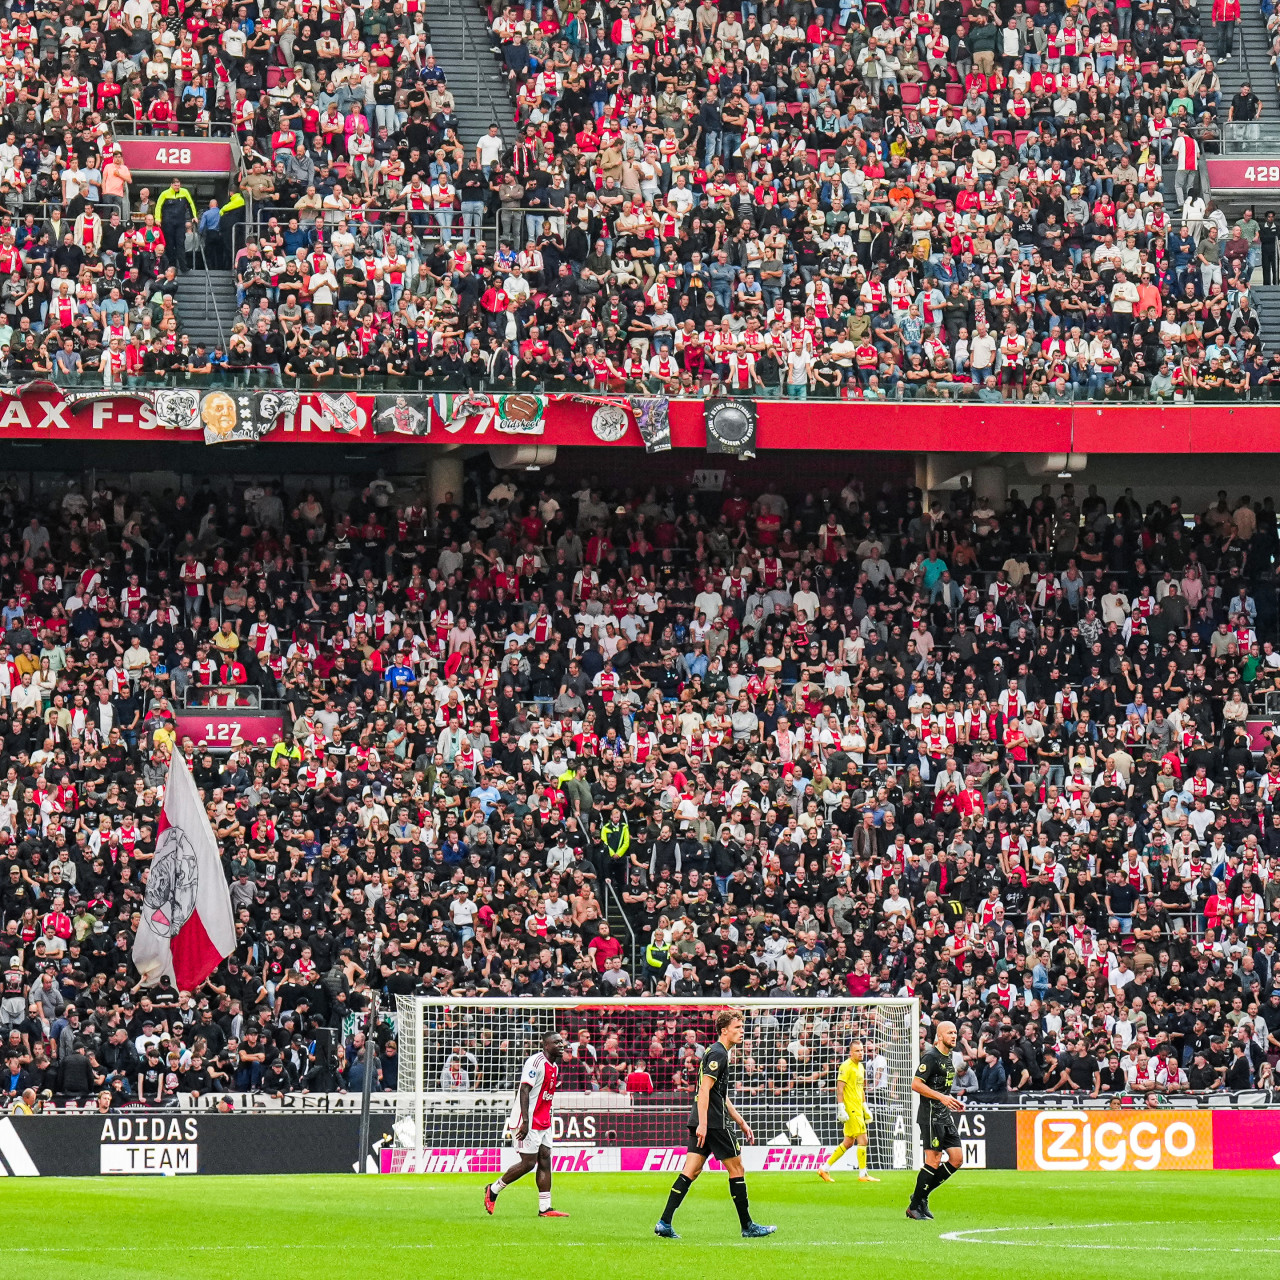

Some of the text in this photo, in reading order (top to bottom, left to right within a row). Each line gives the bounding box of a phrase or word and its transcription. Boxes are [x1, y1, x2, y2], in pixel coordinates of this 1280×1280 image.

[155, 148, 191, 164] 428
[1244, 166, 1280, 181] 429
[205, 723, 241, 740] 127
[948, 900, 963, 915] 11
[101, 1118, 198, 1142] ADIDAS
[1034, 1111, 1195, 1170] Ziggo
[127, 1148, 189, 1170] TEAM
